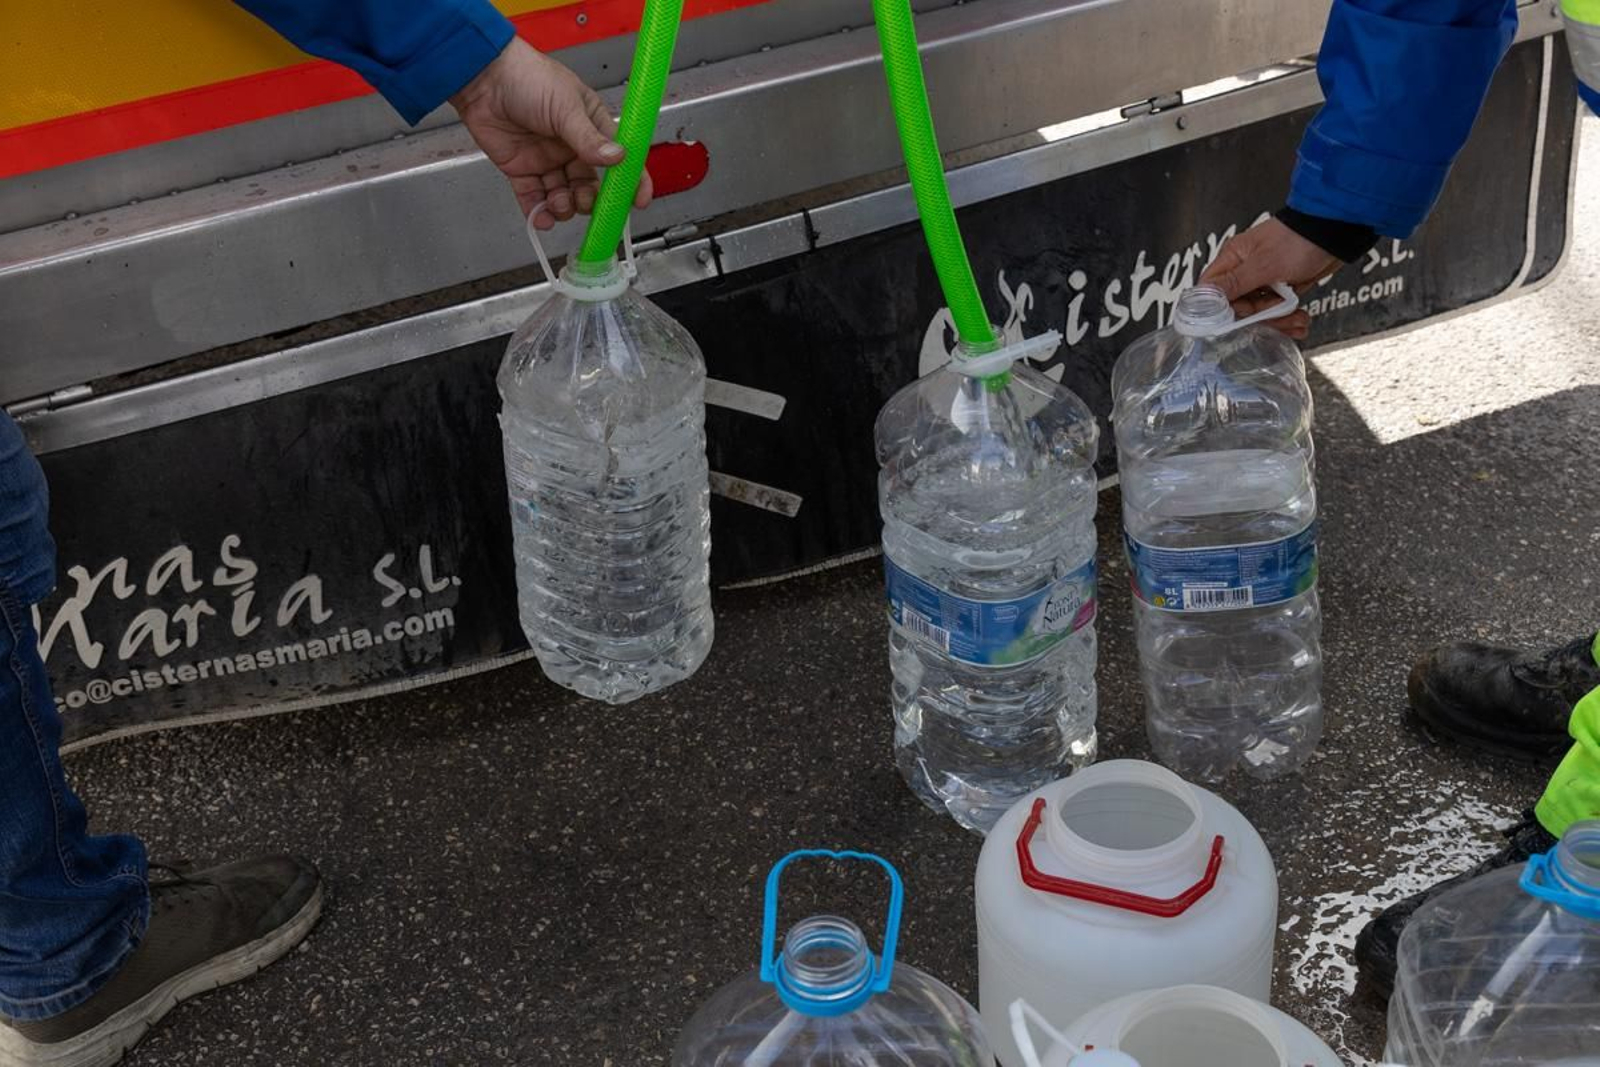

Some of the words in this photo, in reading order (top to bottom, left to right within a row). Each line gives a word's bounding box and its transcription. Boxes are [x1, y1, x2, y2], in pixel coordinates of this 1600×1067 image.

[1301, 275, 1404, 317] aria.com
[68, 534, 259, 613] nas
[373, 544, 461, 607] S.L.
[54, 607, 455, 713] co@cisternasmaria.com
